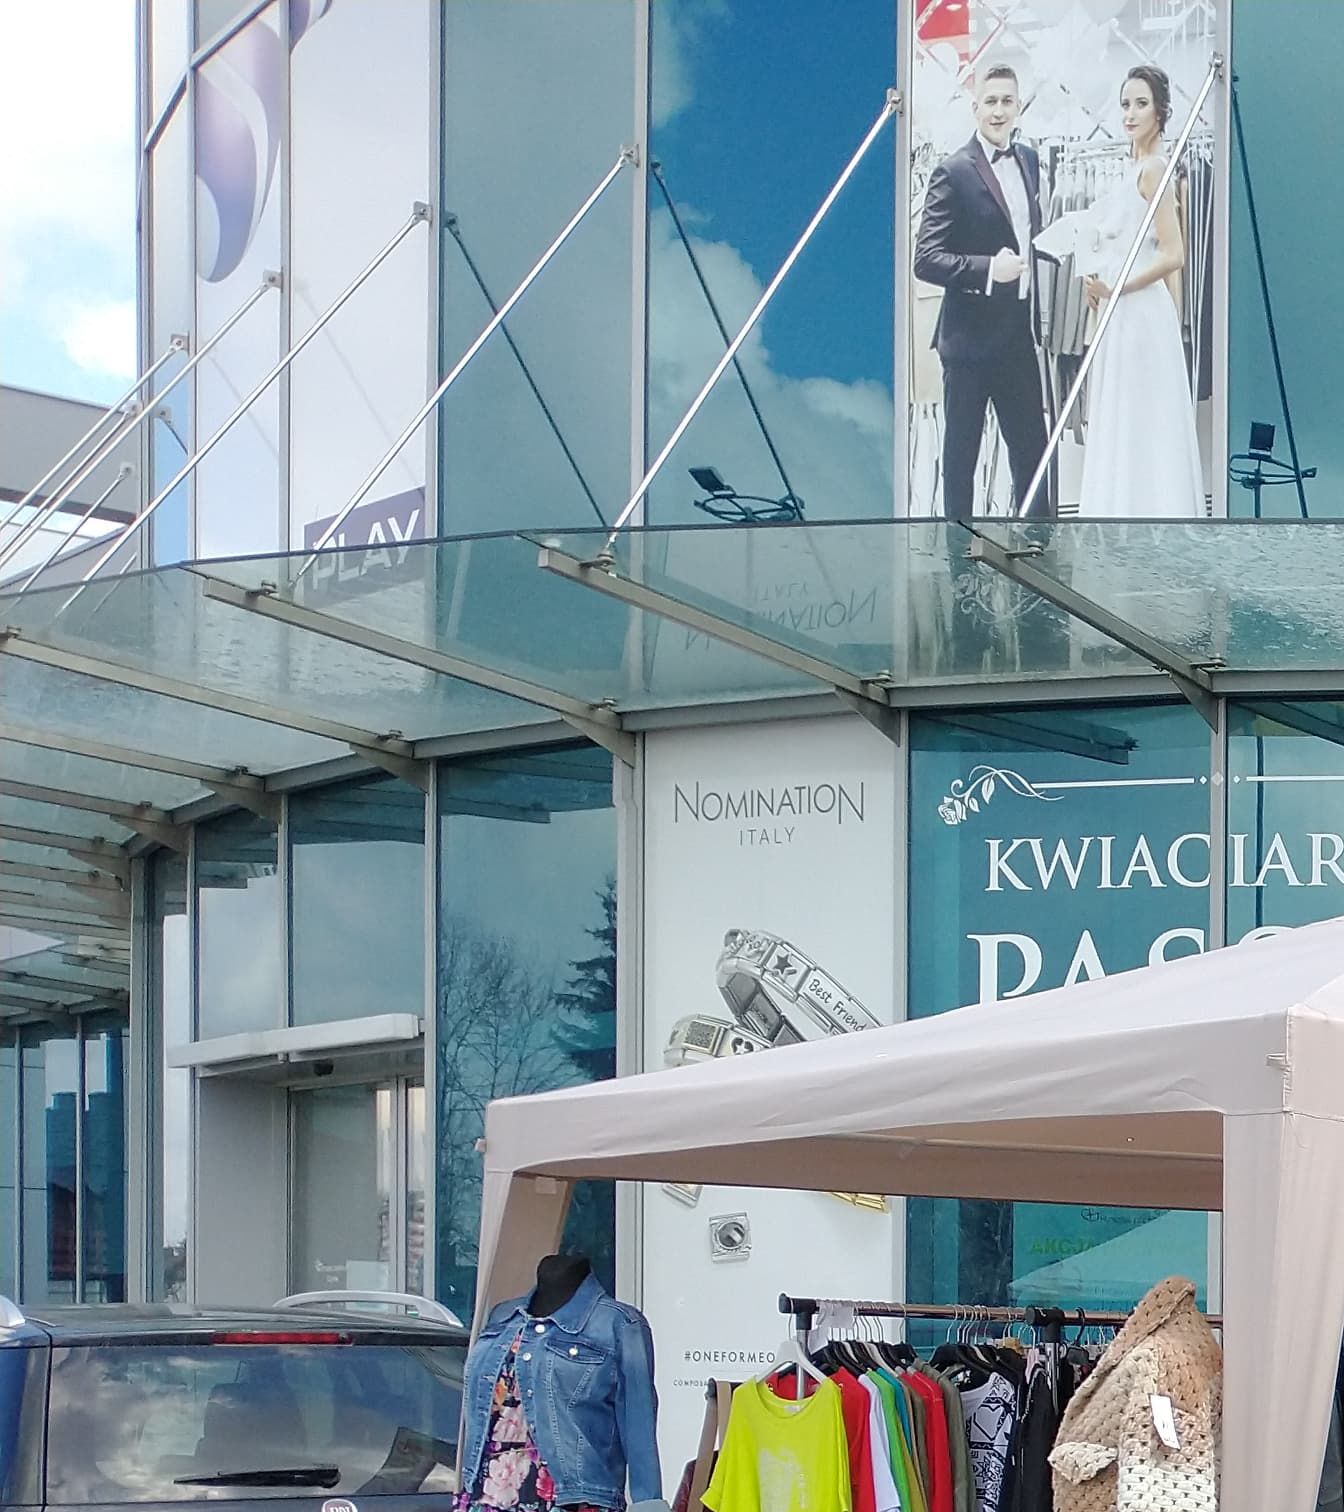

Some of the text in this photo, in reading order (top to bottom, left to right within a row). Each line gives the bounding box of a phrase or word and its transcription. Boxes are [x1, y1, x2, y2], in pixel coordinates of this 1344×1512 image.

[312, 508, 420, 590] PLAY
[740, 826, 796, 846] ITALY
[808, 978, 833, 1004] Best
